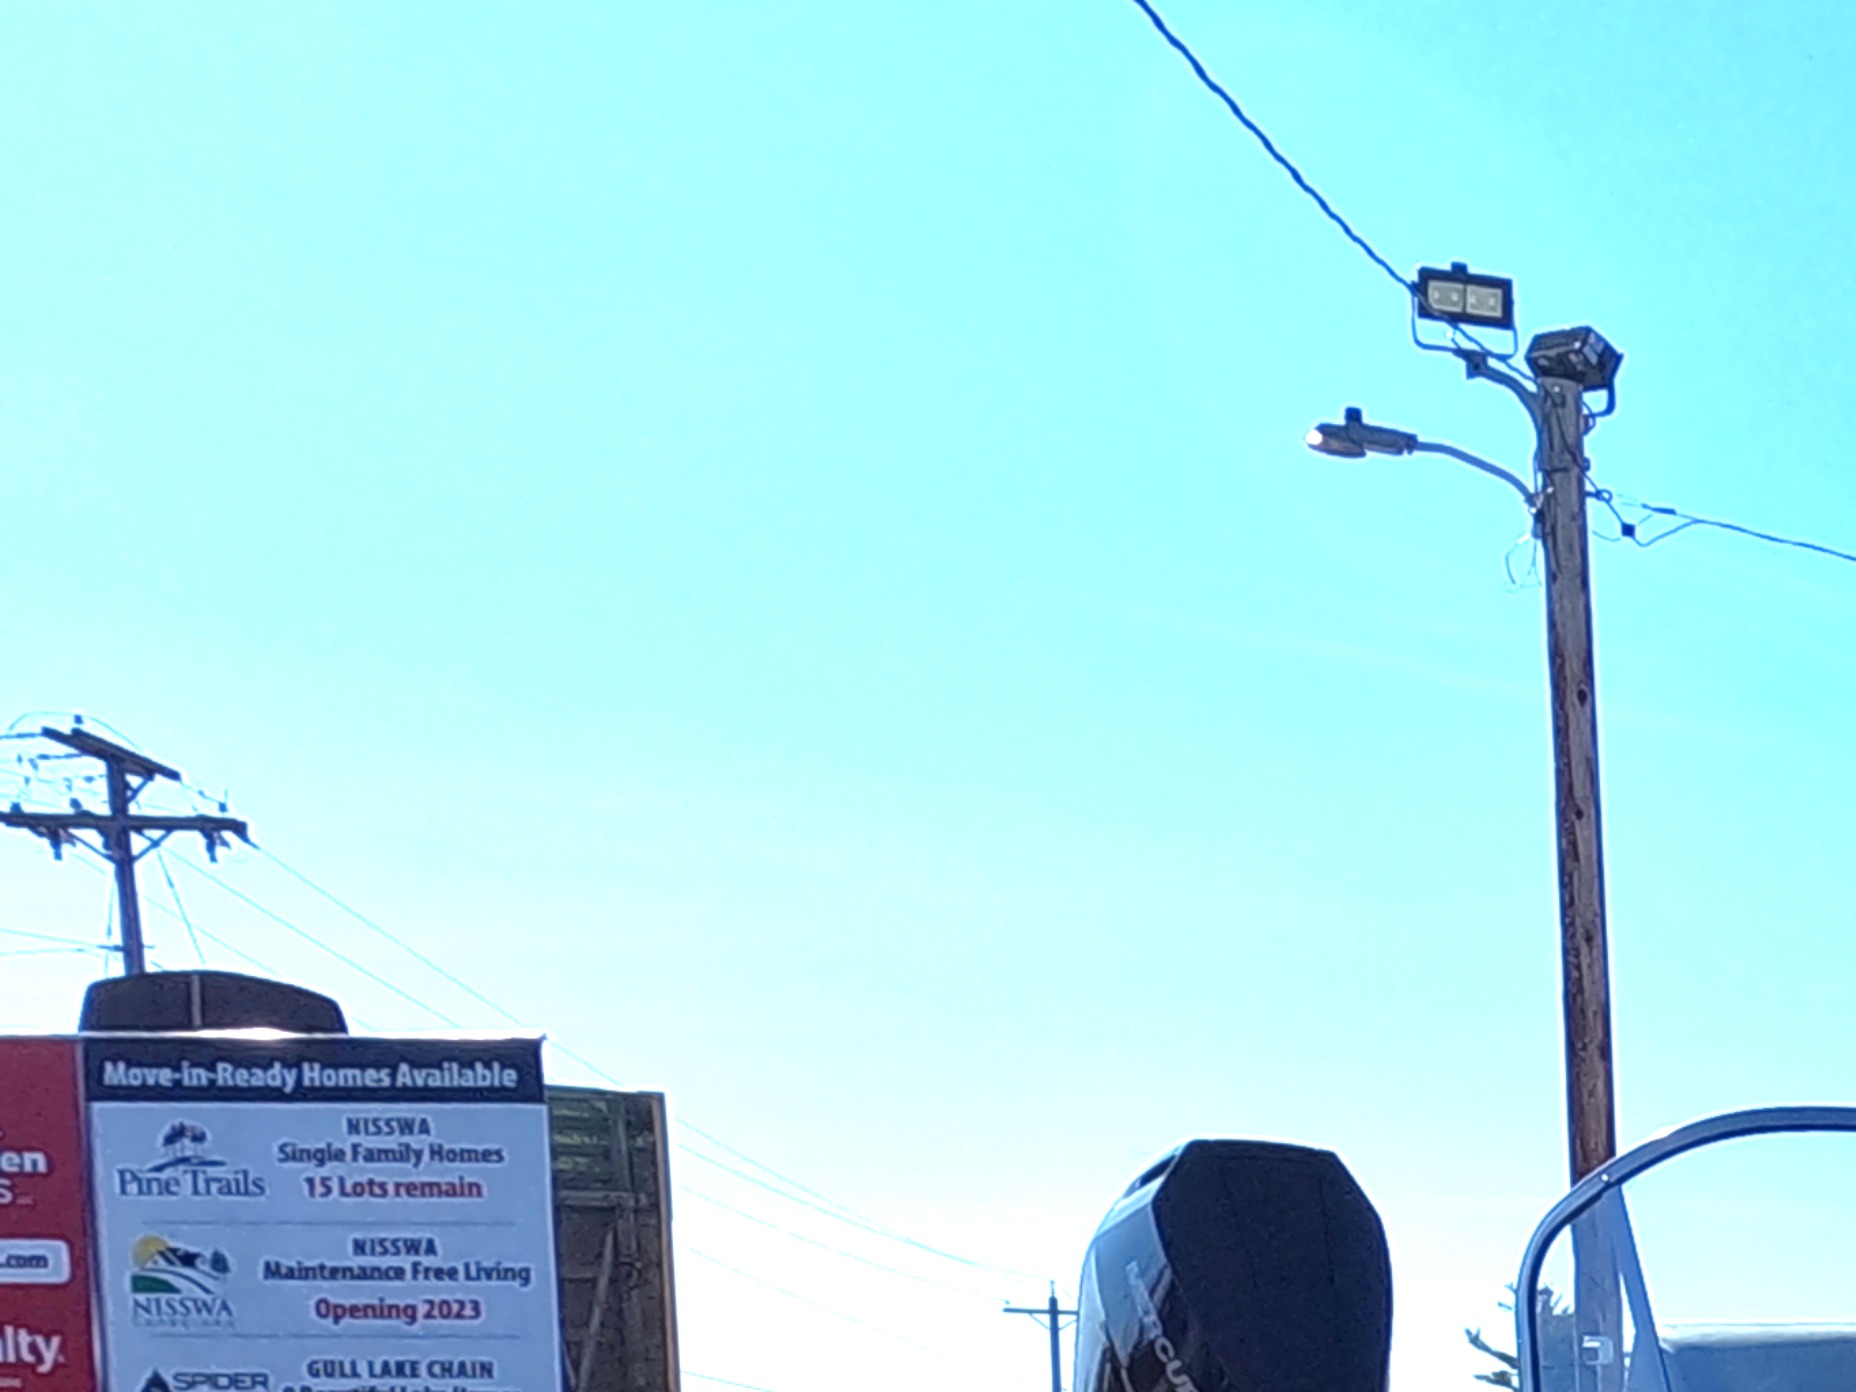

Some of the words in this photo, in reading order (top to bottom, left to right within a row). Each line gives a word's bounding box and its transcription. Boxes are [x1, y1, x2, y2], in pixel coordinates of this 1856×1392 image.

[103, 1060, 297, 1094] Move-in-Ready
[302, 1061, 392, 1088] Homes
[395, 1060, 518, 1089] Available
[345, 1116, 432, 1137] NISSWA
[277, 1142, 347, 1168] Single
[351, 1143, 425, 1169] Family
[428, 1144, 505, 1164] Homes
[115, 1168, 181, 1197] Pine
[183, 1168, 266, 1198] Trails
[304, 1176, 333, 1199] 15
[339, 1176, 389, 1199] Lots
[394, 1175, 484, 1199] remain
[352, 1237, 439, 1257] NISSWA
[263, 1260, 406, 1282] Maintenance
[411, 1261, 459, 1282] Free
[464, 1261, 531, 1287] Living
[132, 1297, 235, 1318] NISSWA
[314, 1297, 418, 1326] Opening
[422, 1298, 483, 1321] 2023
[172, 1371, 270, 1391] SPIDER
[306, 1359, 361, 1379] GULL
[368, 1359, 421, 1379] LAKE
[427, 1359, 496, 1380] CHAIN
